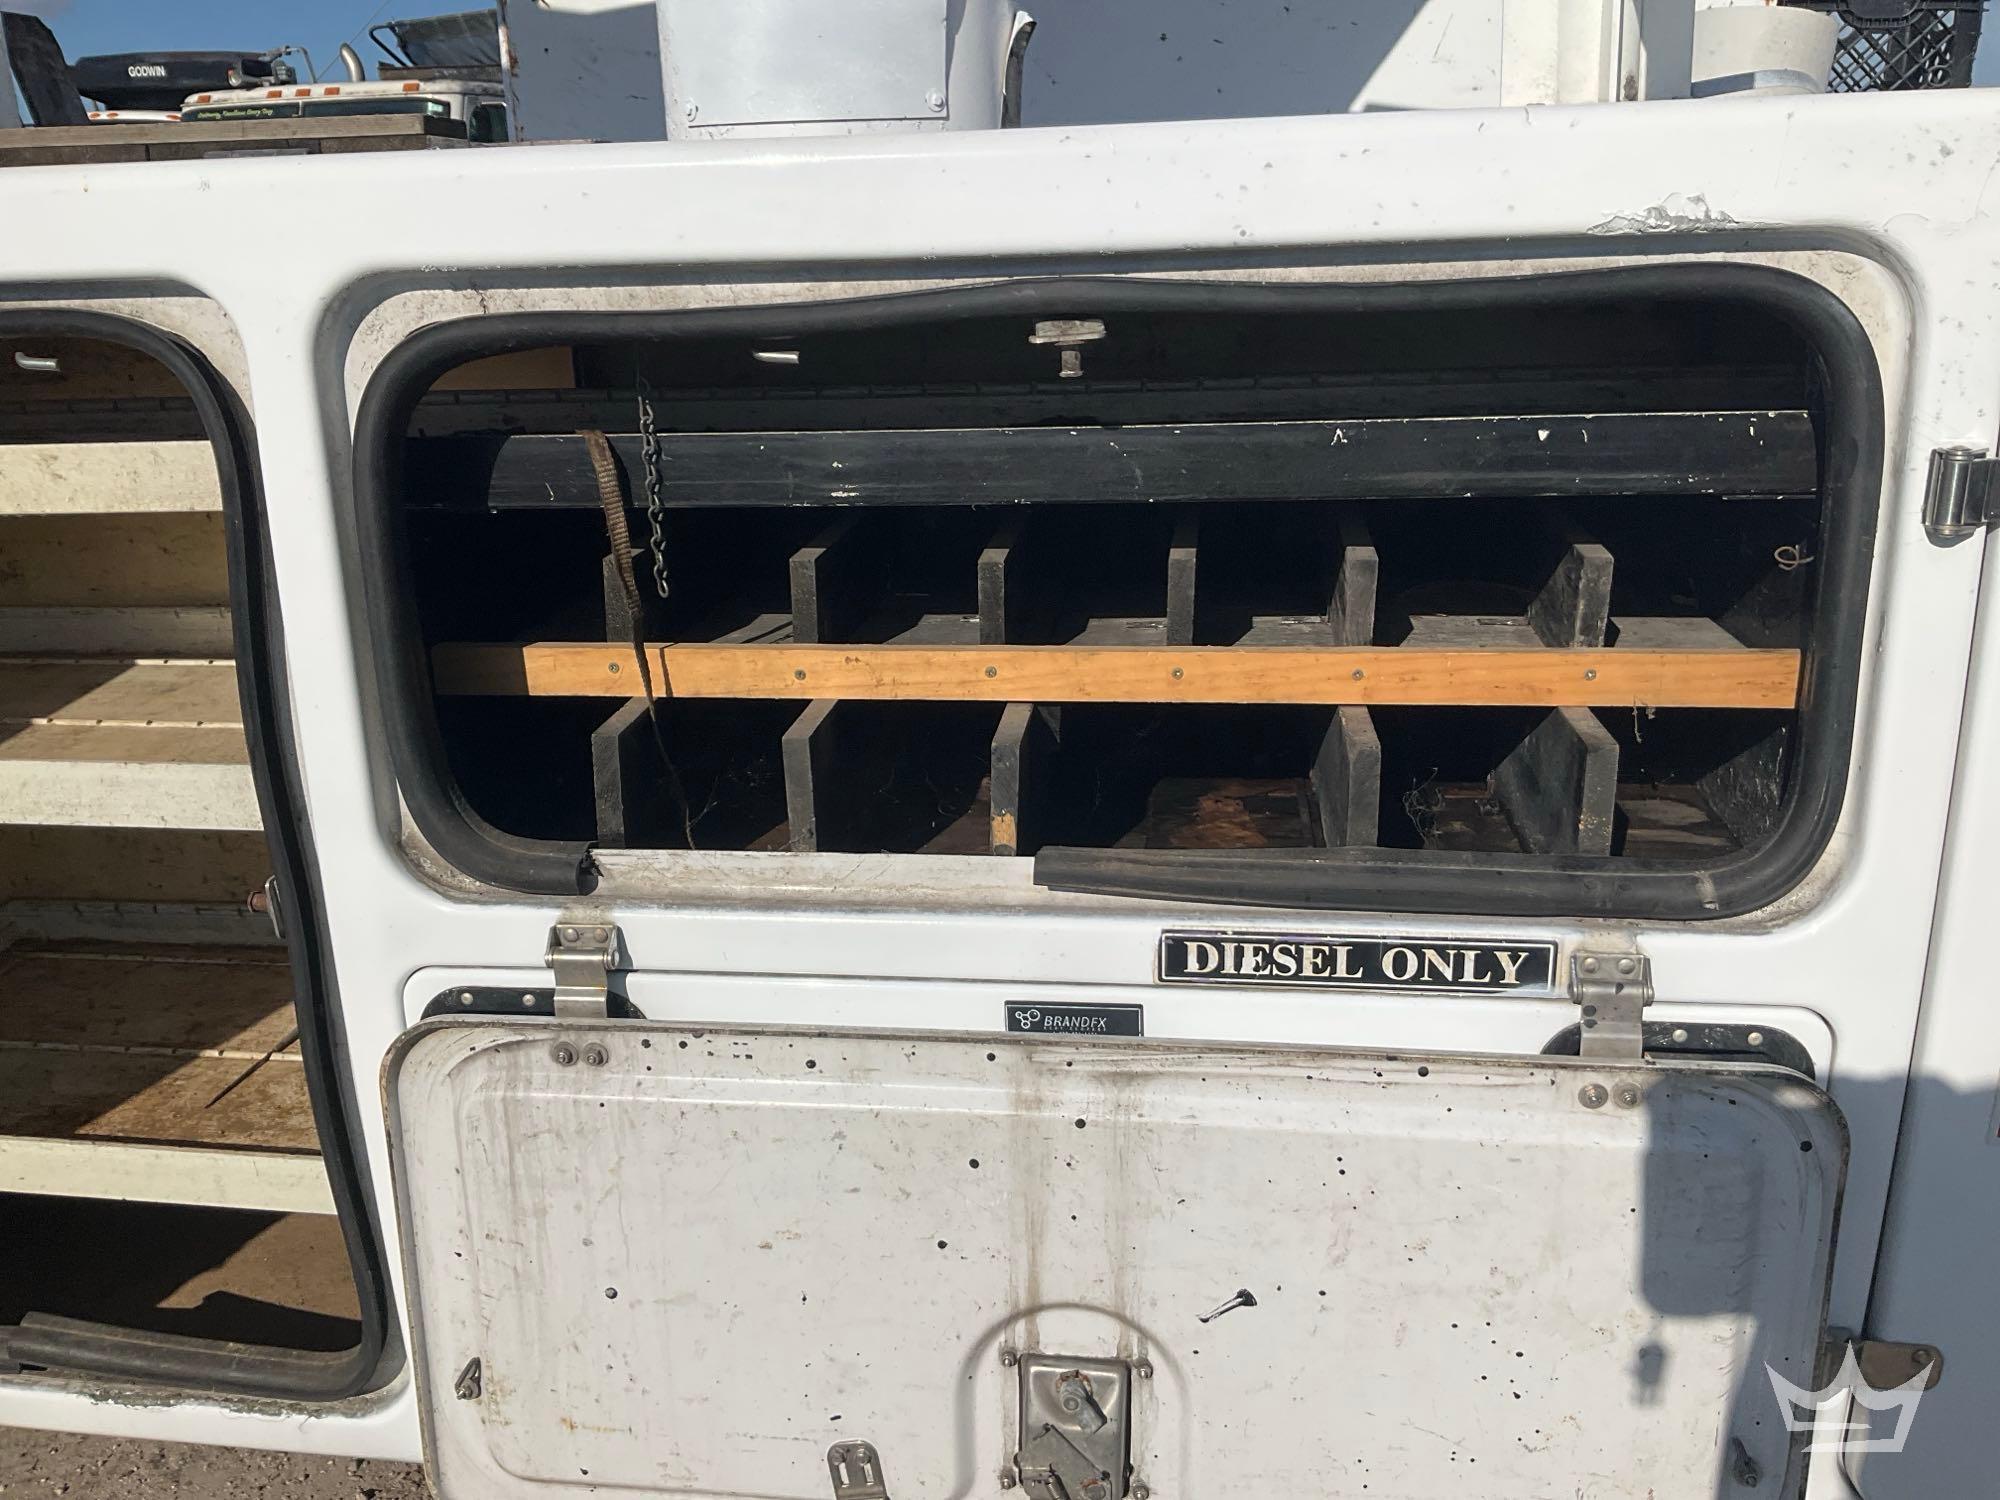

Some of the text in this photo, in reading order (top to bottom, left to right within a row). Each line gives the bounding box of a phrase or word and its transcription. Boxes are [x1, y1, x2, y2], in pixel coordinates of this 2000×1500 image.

[127, 65, 166, 78] GODWIN
[1183, 940, 1530, 984] DIESEL ONLY
[1044, 1015, 1107, 1028] BRANDFX
